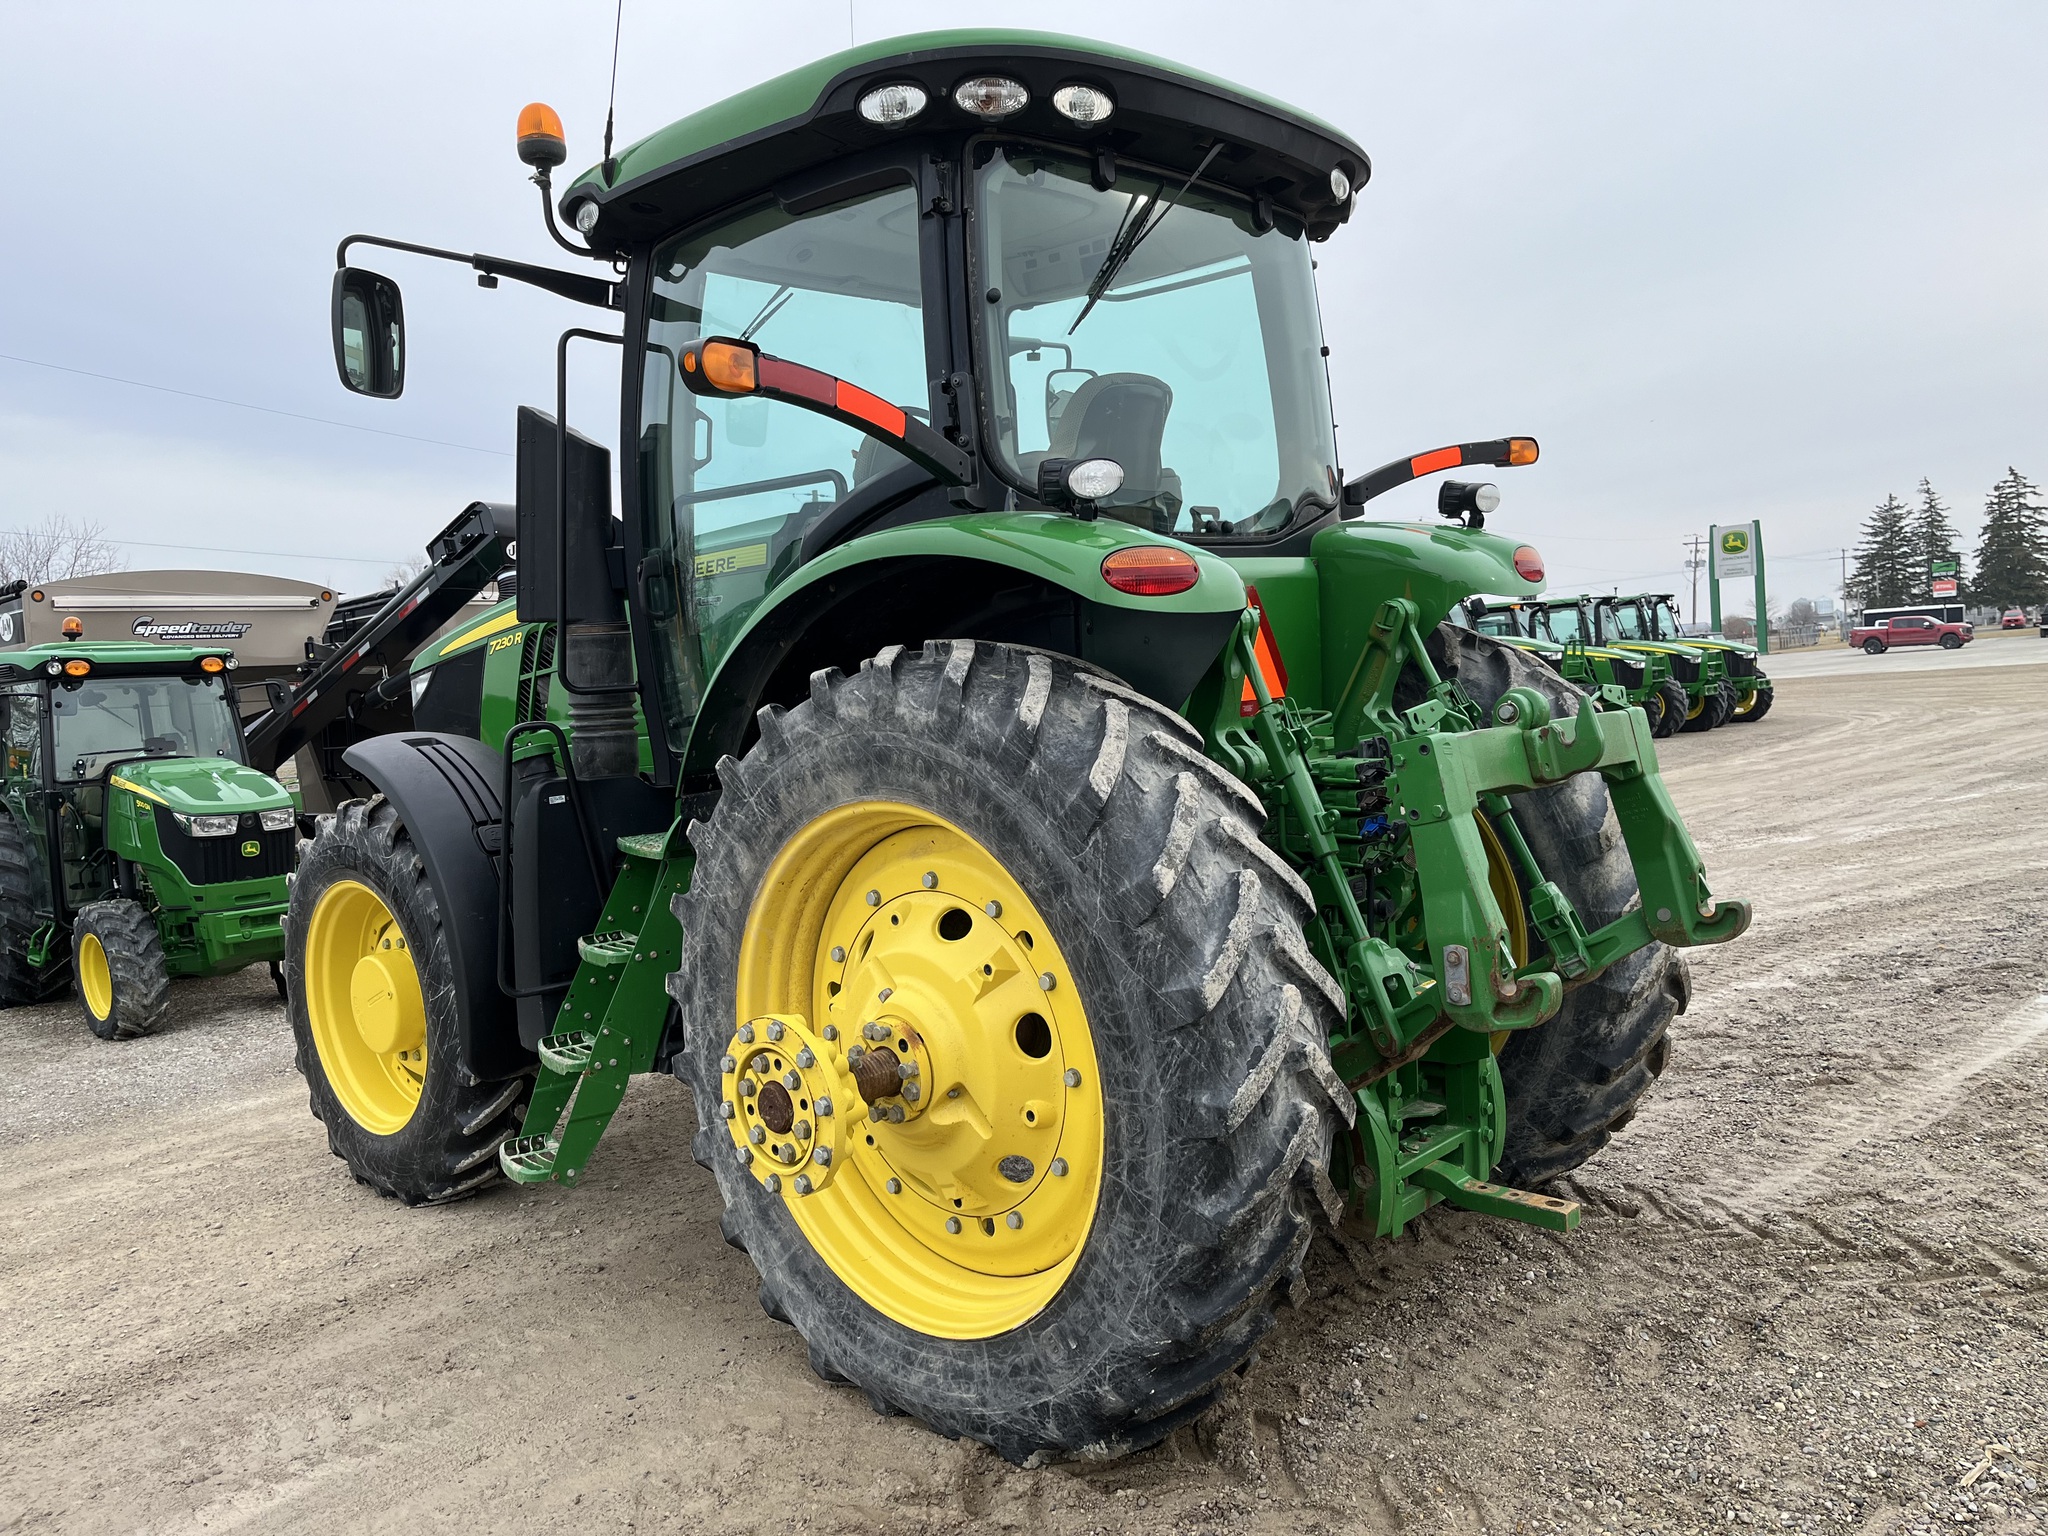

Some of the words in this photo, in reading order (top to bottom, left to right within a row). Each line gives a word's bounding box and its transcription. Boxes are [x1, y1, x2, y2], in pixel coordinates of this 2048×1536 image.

[695, 555, 737, 576] EERE
[489, 634, 514, 655] 7230
[514, 631, 523, 645] R
